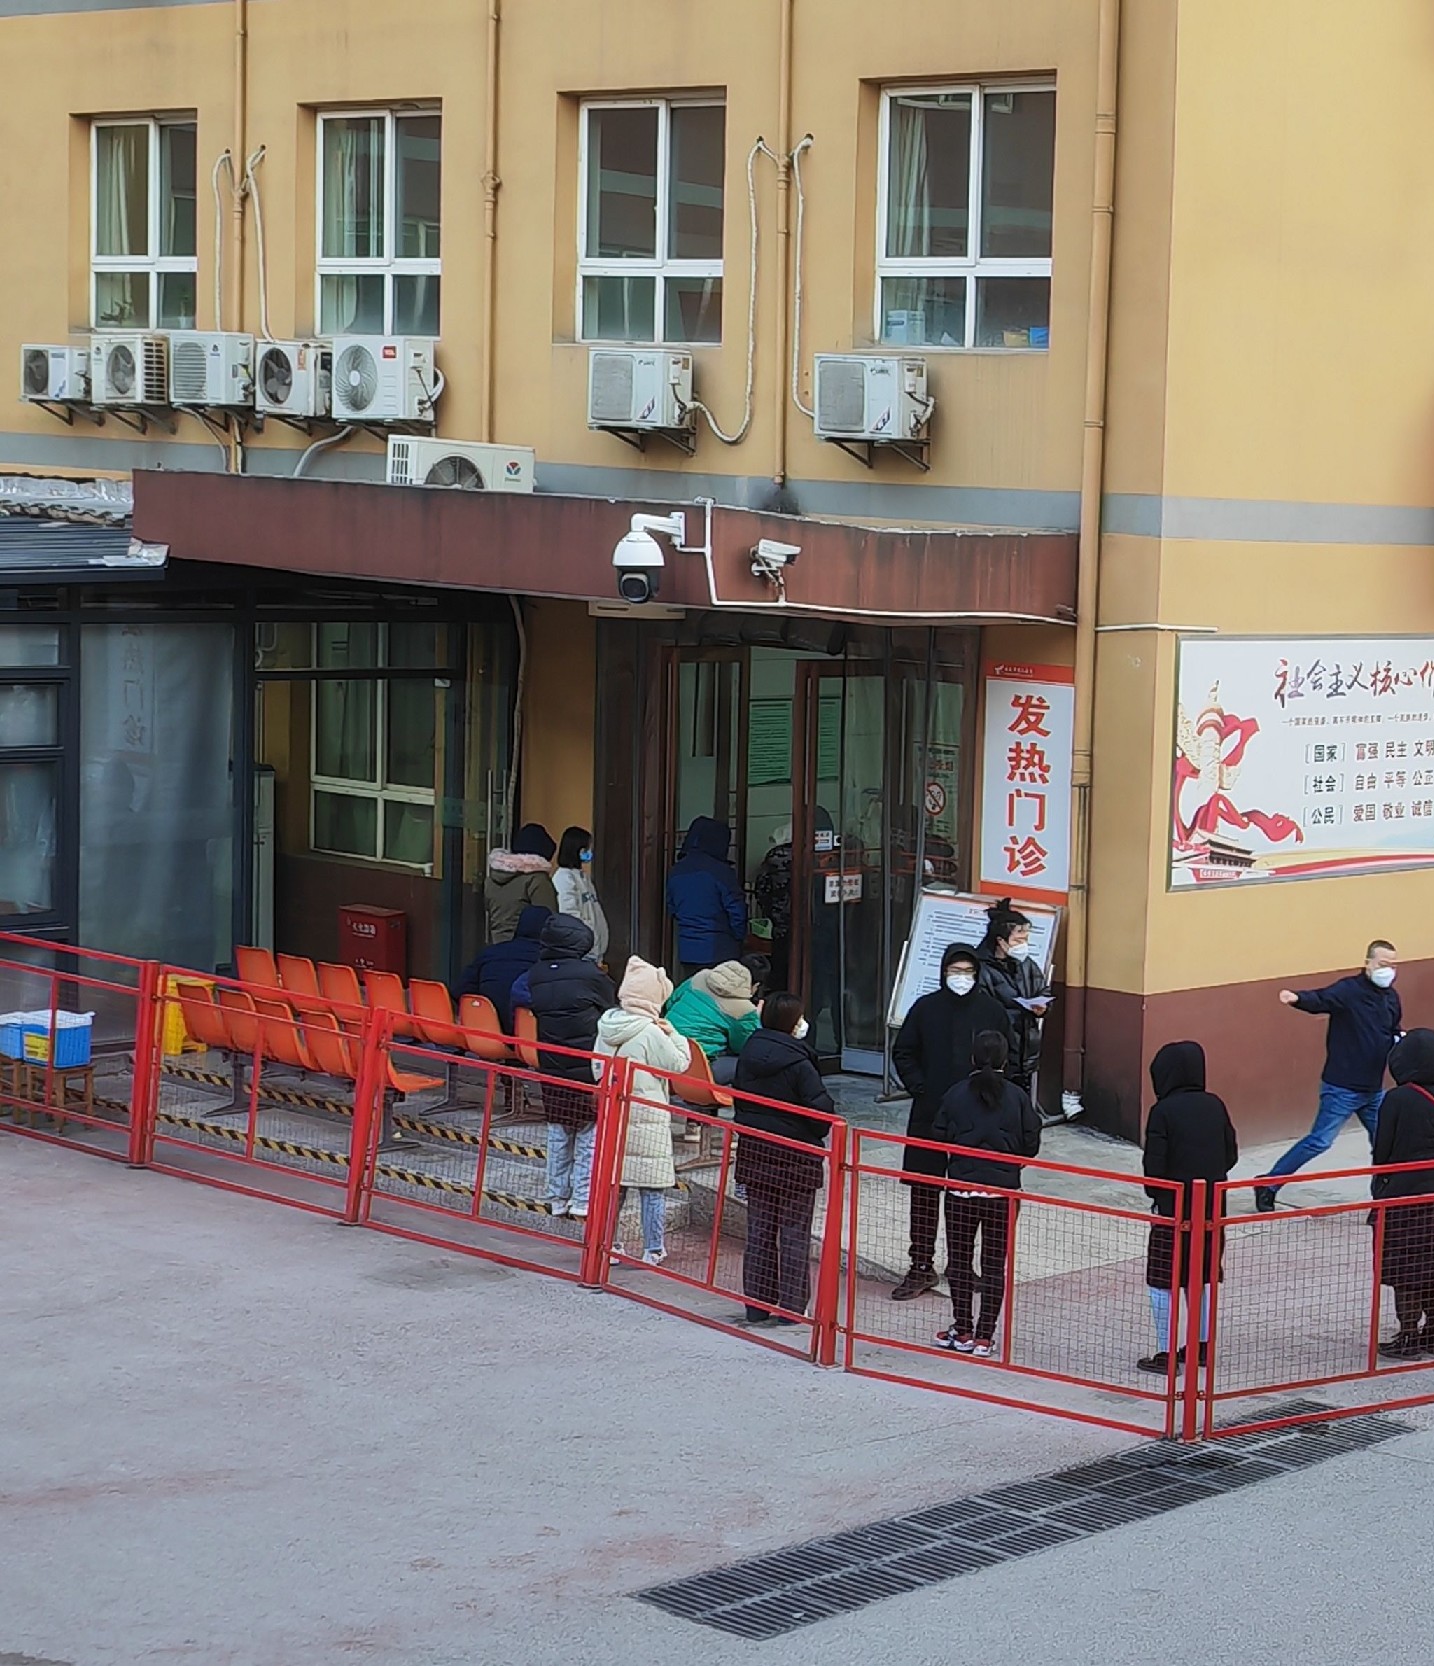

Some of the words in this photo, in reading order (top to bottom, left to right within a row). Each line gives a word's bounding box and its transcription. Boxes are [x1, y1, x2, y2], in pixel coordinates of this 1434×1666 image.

[1385, 740, 1408, 759] 民主
[1004, 694, 1051, 877] 发热门诊
[1355, 772, 1378, 791] 自由
[1384, 770, 1407, 788] 平等
[1412, 769, 1434, 786] 公正
[1353, 803, 1377, 822] 爱国
[1382, 801, 1406, 820] 敬业
[1411, 799, 1433, 817] 诚信
